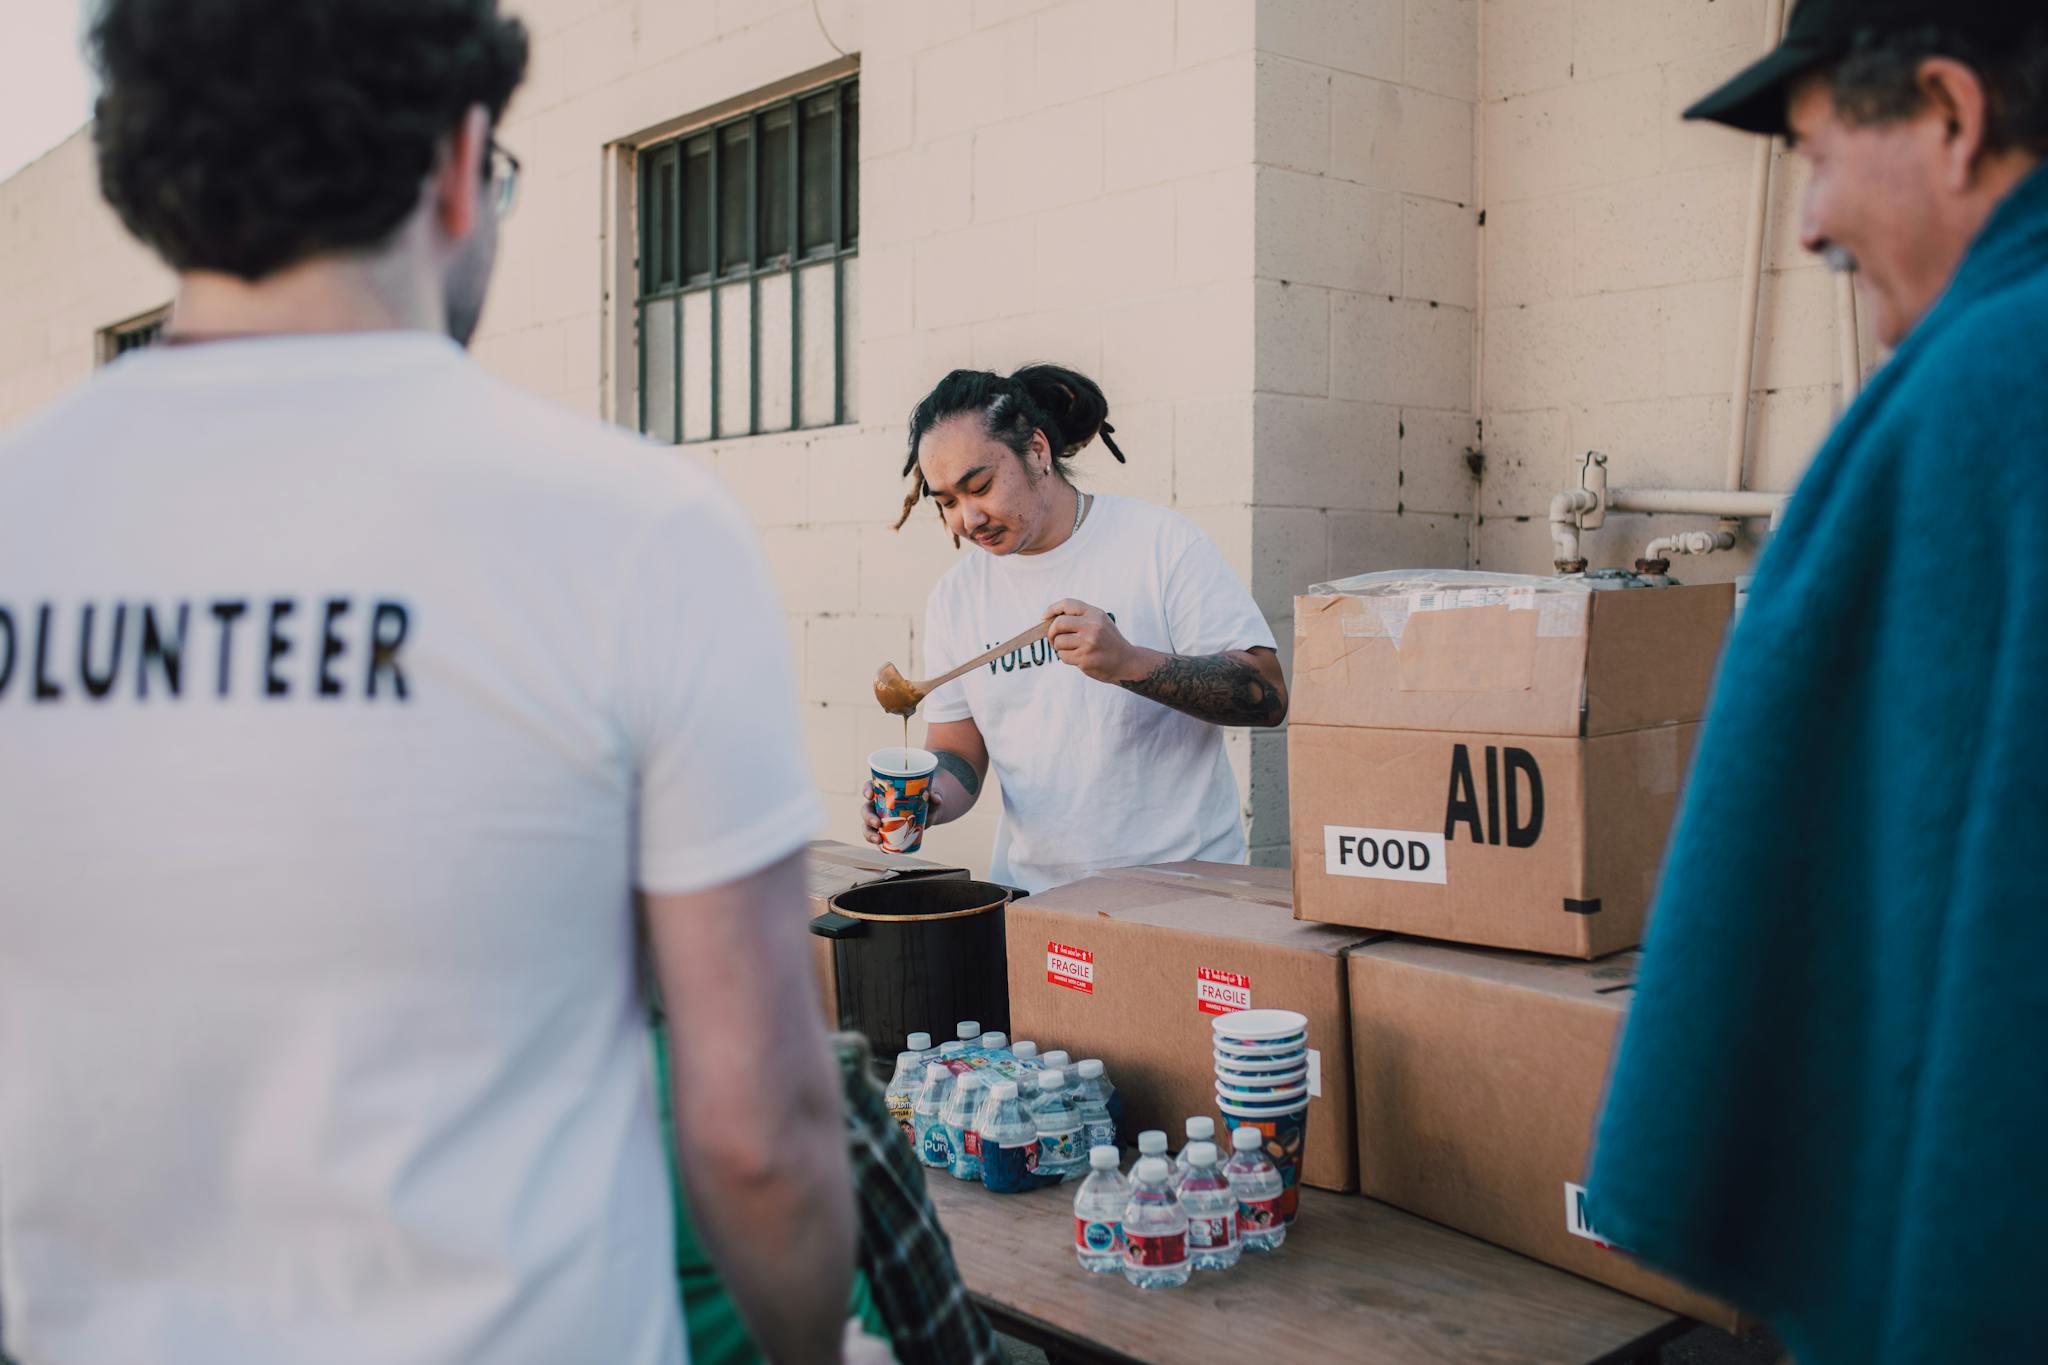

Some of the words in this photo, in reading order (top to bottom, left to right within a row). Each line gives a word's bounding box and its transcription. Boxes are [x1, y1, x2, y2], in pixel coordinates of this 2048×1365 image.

[1444, 743, 1544, 849] AID
[1338, 835, 1431, 871] FOOD
[1051, 958, 1089, 978] FRAGILE
[1202, 984, 1247, 1005] FRAGILE
